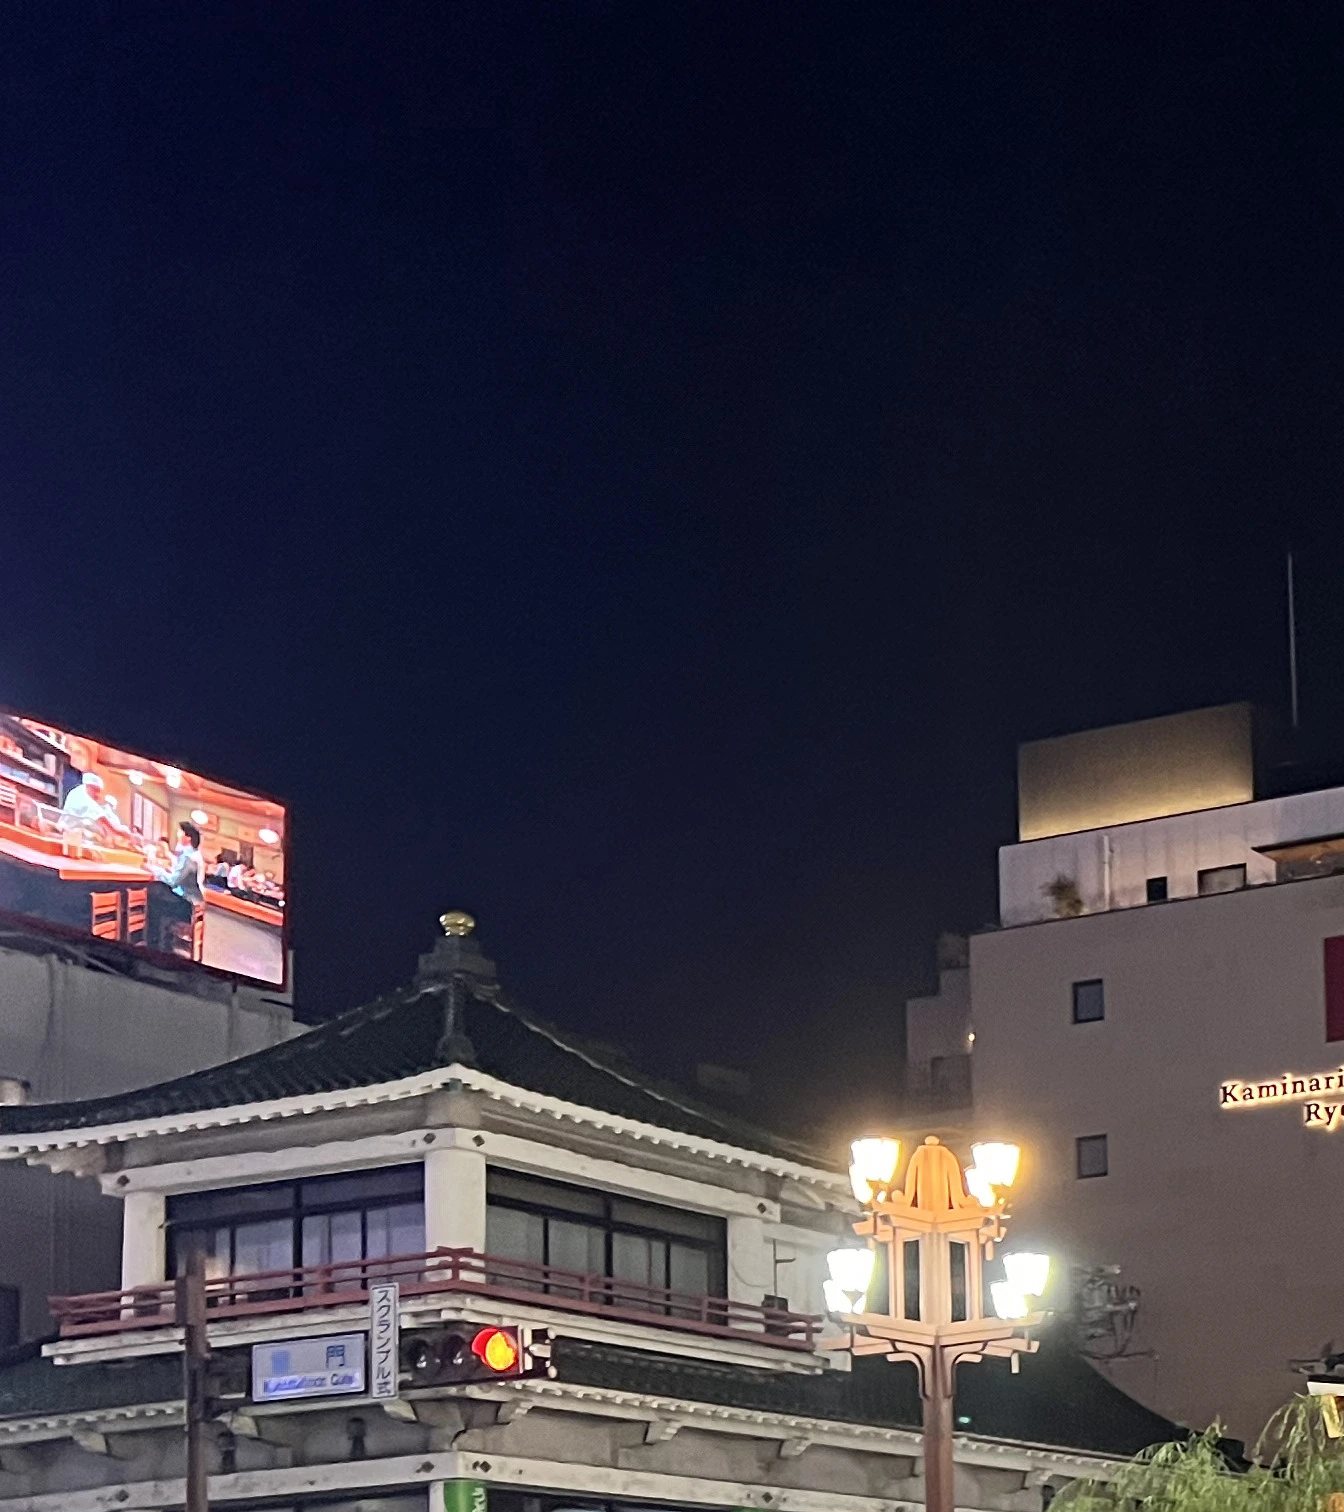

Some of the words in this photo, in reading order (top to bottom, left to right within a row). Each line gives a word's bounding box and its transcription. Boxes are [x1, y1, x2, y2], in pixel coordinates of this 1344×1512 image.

[376, 1289, 391, 1395] スクランブル式
